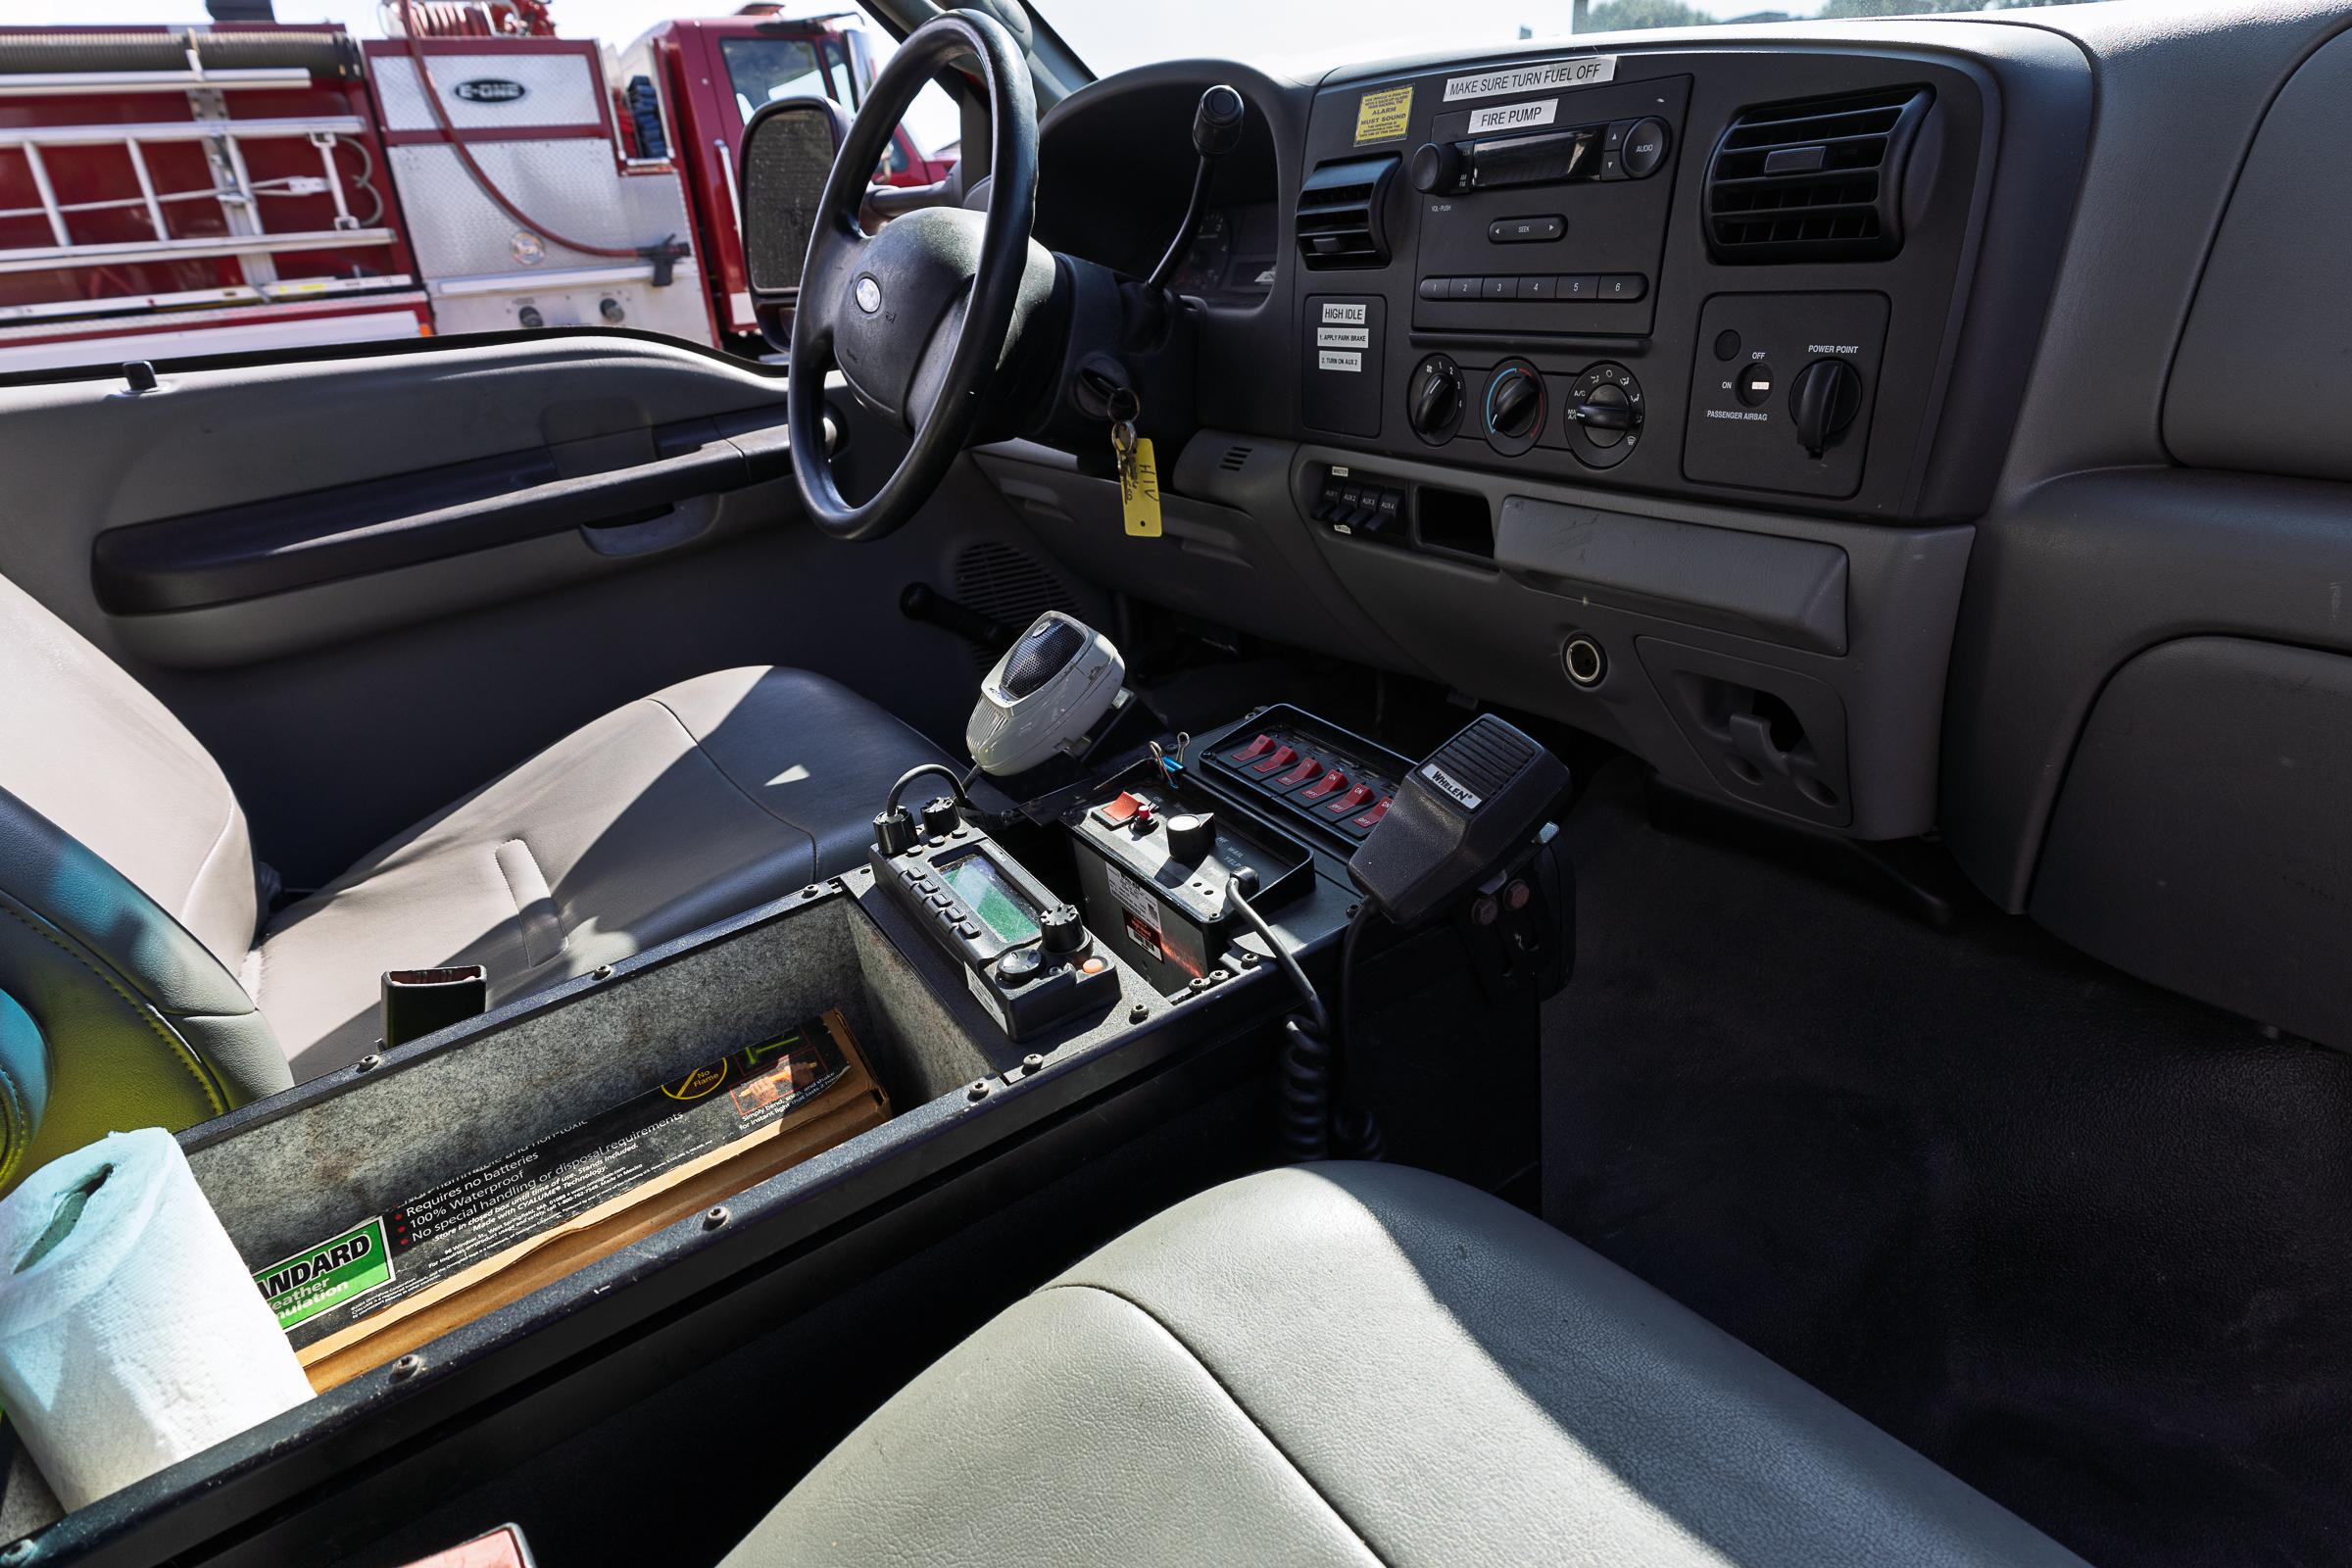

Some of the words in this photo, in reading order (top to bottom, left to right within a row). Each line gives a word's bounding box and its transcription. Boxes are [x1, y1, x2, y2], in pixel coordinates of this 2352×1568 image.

[1450, 81, 1478, 96] MAKE
[1480, 78, 1509, 92] SURE
[1512, 74, 1542, 89] TURN
[1544, 69, 1574, 84] FUEL
[1576, 64, 1601, 79] OFF
[1372, 106, 1396, 115] ALARM
[1381, 113, 1406, 122] SOUND
[1481, 111, 1505, 127] FIRE
[1508, 107, 1542, 123] PUMP
[1636, 144, 1654, 153] AUDIO
[1433, 284, 1437, 292] 1
[1462, 284, 1468, 292] 2
[1497, 283, 1502, 292] 3
[1533, 283, 1538, 292] 4
[1573, 283, 1579, 292] 5
[1615, 283, 1620, 292] 6
[1325, 308, 1343, 319] HIGH
[1345, 309, 1363, 320] IDLE
[1808, 345, 1835, 353] POWER
[1836, 345, 1858, 354] POINT
[1707, 410, 1743, 420] PASSENGER
[1743, 413, 1767, 421] AIRBAG
[693, 1073, 719, 1088] Flame
[697, 1070, 710, 1079] No
[741, 1107, 764, 1121] Simply
[803, 1081, 816, 1091] and
[738, 1122, 749, 1130] for
[750, 1110, 774, 1125] instant
[773, 1102, 789, 1113] light
[790, 1095, 805, 1104] that
[804, 1087, 819, 1096] lasts
[412, 1228, 431, 1241] No
[434, 1204, 477, 1231] special
[479, 1179, 538, 1209] handling
[539, 1171, 551, 1182] or
[555, 1146, 604, 1174] disposal
[605, 1112, 684, 1152] requirements
[406, 1186, 461, 1216] Requires
[464, 1178, 481, 1190] no
[483, 1152, 538, 1181] batteries
[434, 1227, 456, 1241] Store
[467, 1208, 493, 1225] closed
[494, 1202, 509, 1213] box
[511, 1191, 529, 1205] until
[531, 1184, 549, 1196] time
[550, 1177, 560, 1186] of
[577, 1159, 603, 1174] Stands
[604, 1142, 638, 1162] included.
[472, 1217, 495, 1231] Made
[497, 1207, 515, 1219] with
[562, 1164, 608, 1188] Technology.
[410, 1206, 446, 1227] 100%
[449, 1169, 523, 1209] Waterproof
[472, 1232, 497, 1247] product
[498, 1224, 514, 1234] usage
[515, 1217, 527, 1226] and
[600, 1176, 616, 1186] Made
[622, 1163, 642, 1175] Mexico
[452, 1236, 478, 1250] Windsor
[487, 1224, 503, 1233] West
